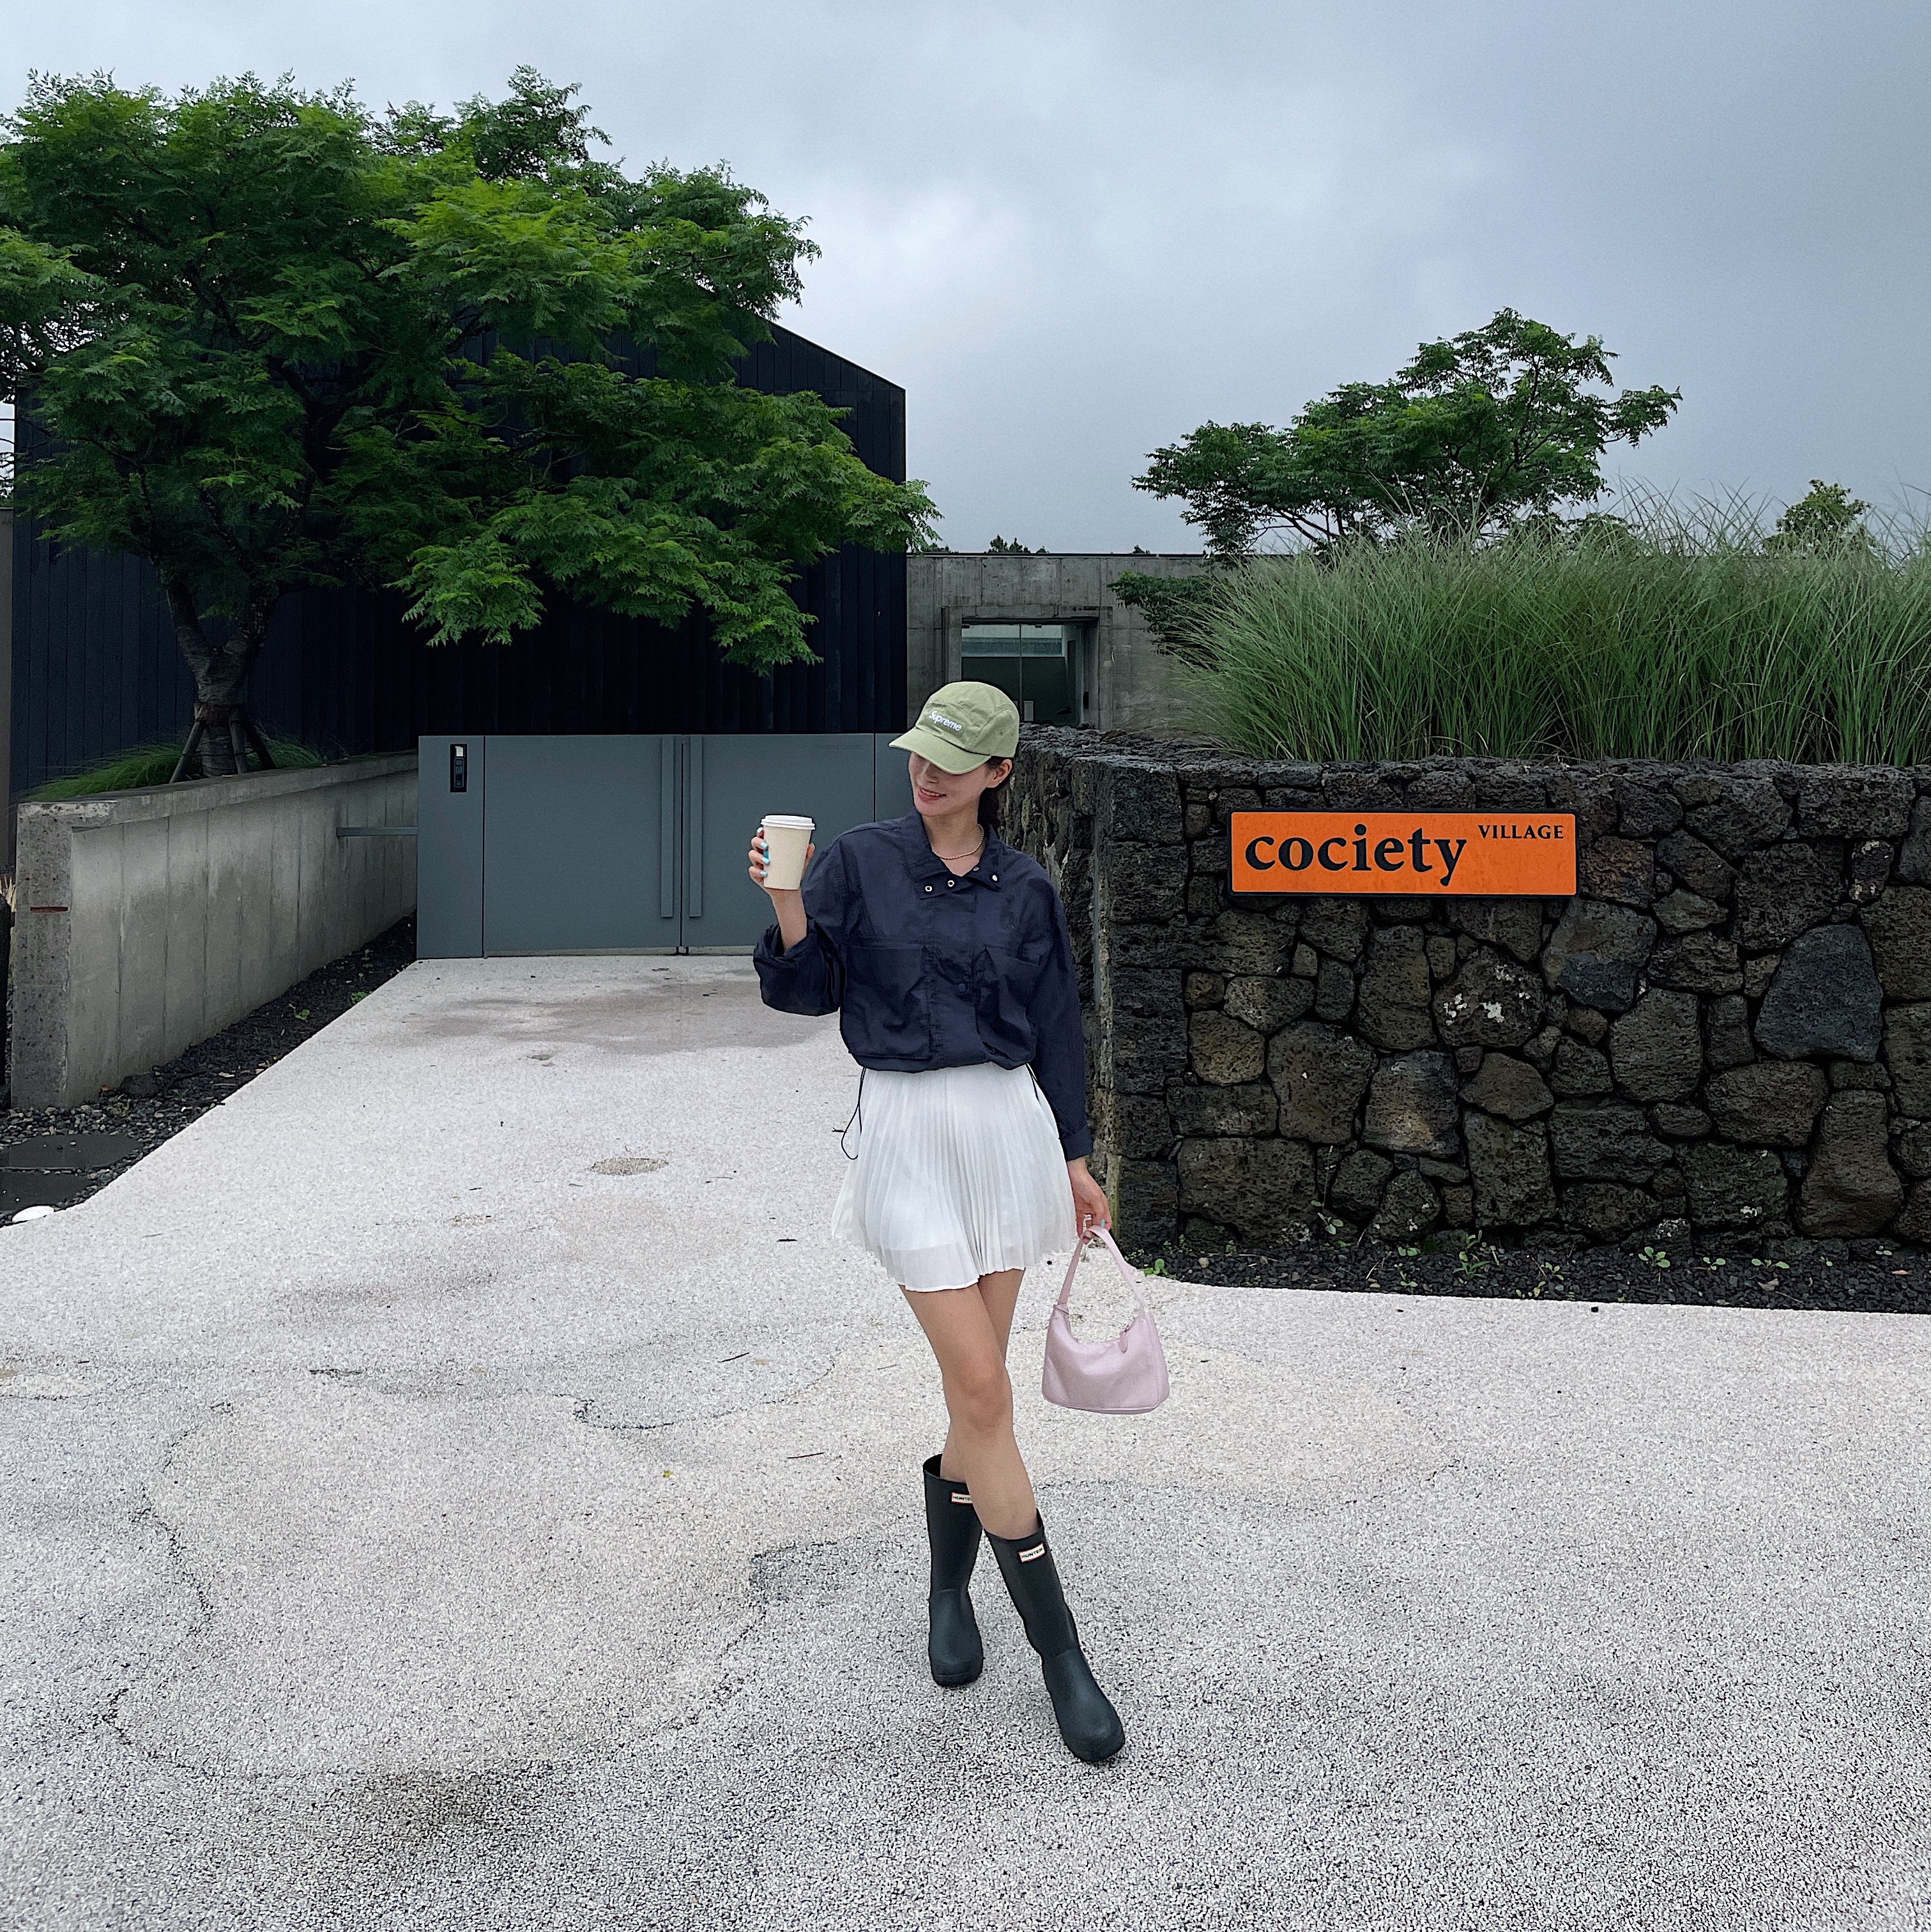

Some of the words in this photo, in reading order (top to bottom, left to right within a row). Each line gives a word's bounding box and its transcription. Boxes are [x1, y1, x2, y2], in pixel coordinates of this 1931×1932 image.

[929, 710, 962, 731] Supreme
[1245, 824, 1467, 887] cociety
[1477, 825, 1564, 839] VILLAGE
[1021, 1547, 1043, 1558] HUNTER
